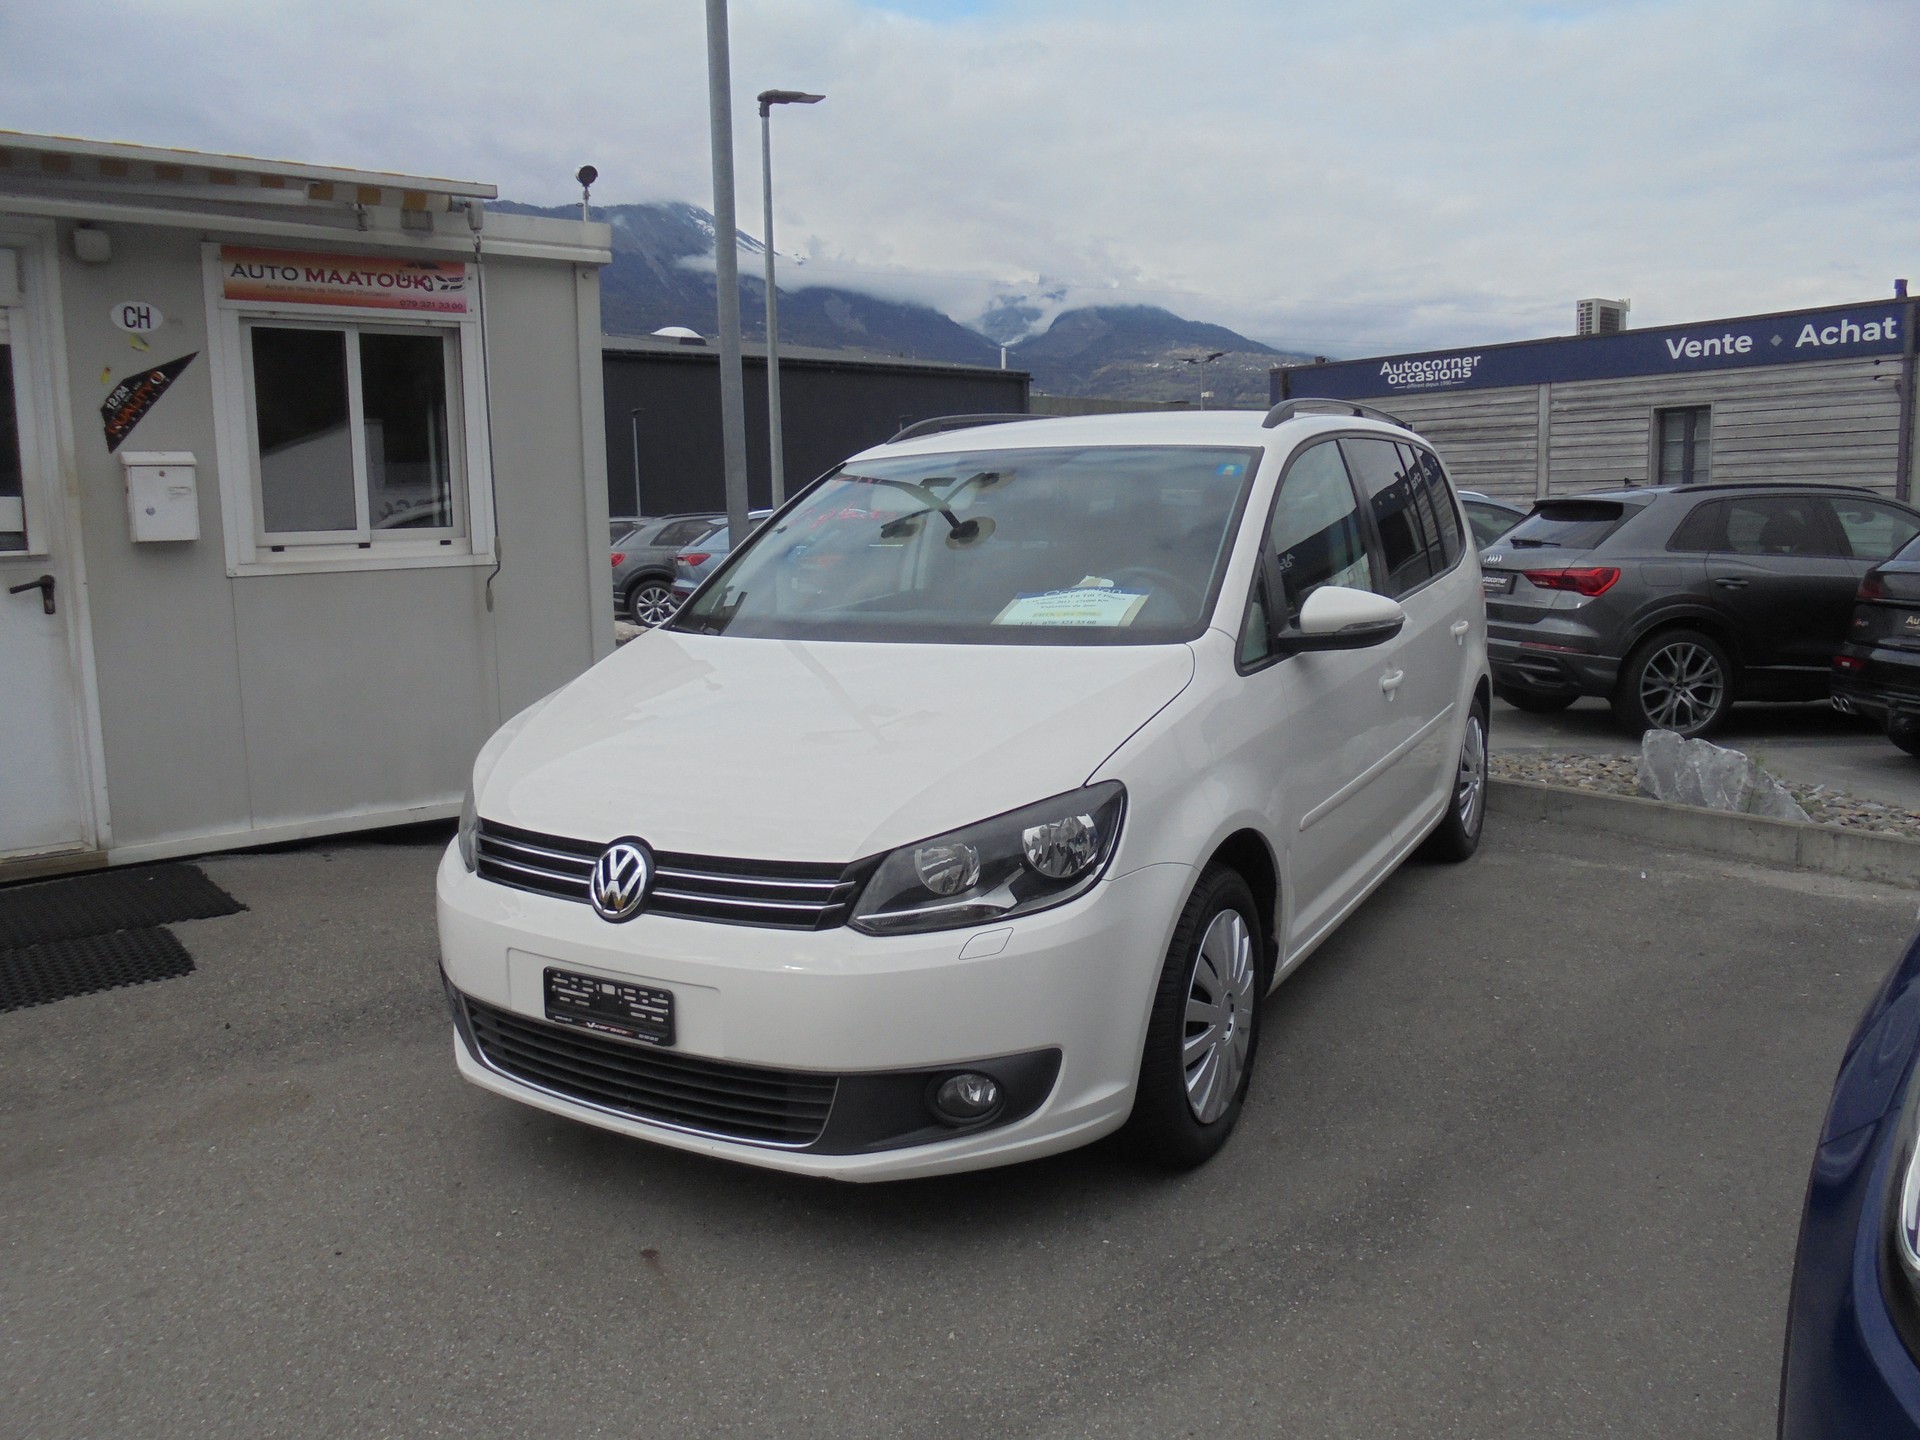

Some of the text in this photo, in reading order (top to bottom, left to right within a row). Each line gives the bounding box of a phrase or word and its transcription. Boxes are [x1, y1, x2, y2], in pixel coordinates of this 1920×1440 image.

[230, 263, 433, 292] AUTO MAATOUK
[123, 306, 151, 328] CH
[1665, 316, 1898, 360] Vente Achat
[1379, 355, 1482, 376] Autocorner
[1387, 367, 1472, 384] occasions
[106, 385, 130, 410] 12/24
